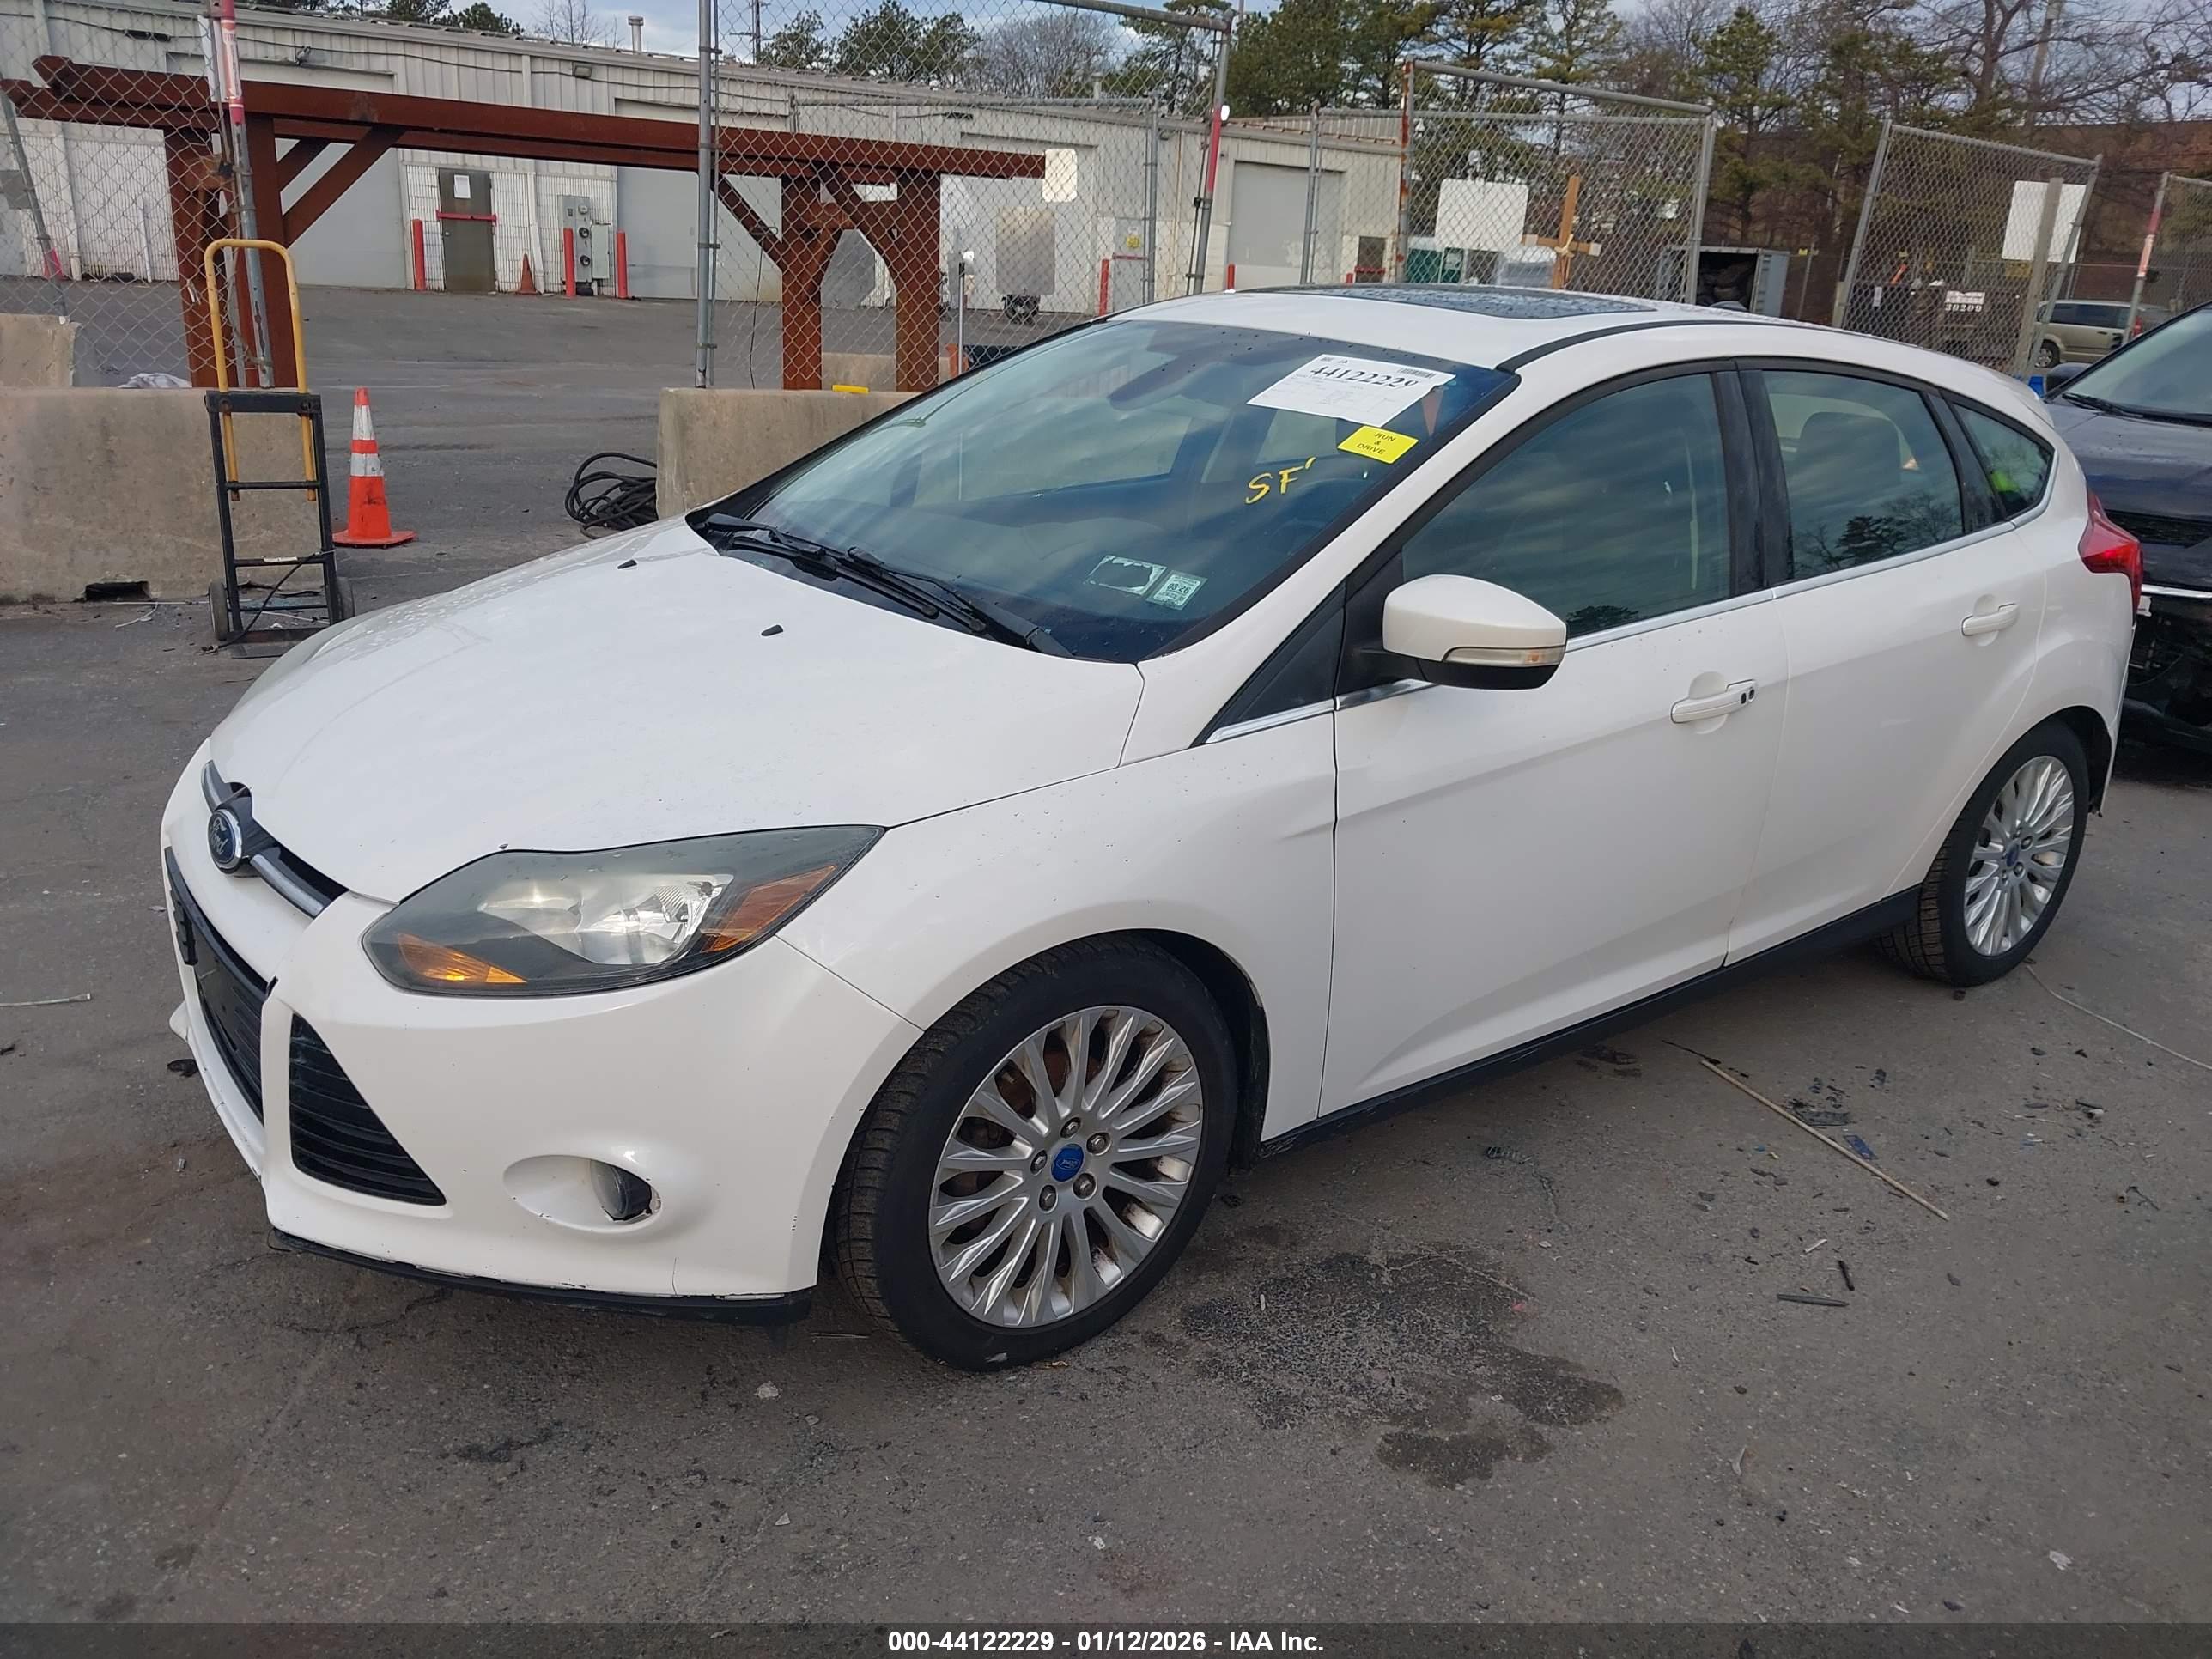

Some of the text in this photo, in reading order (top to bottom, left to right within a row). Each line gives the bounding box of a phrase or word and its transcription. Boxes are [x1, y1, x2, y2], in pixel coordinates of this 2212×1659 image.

[1374, 432, 1396, 442] RUN
[1357, 443, 1386, 455] DRIVE
[209, 817, 229, 855] Ford
